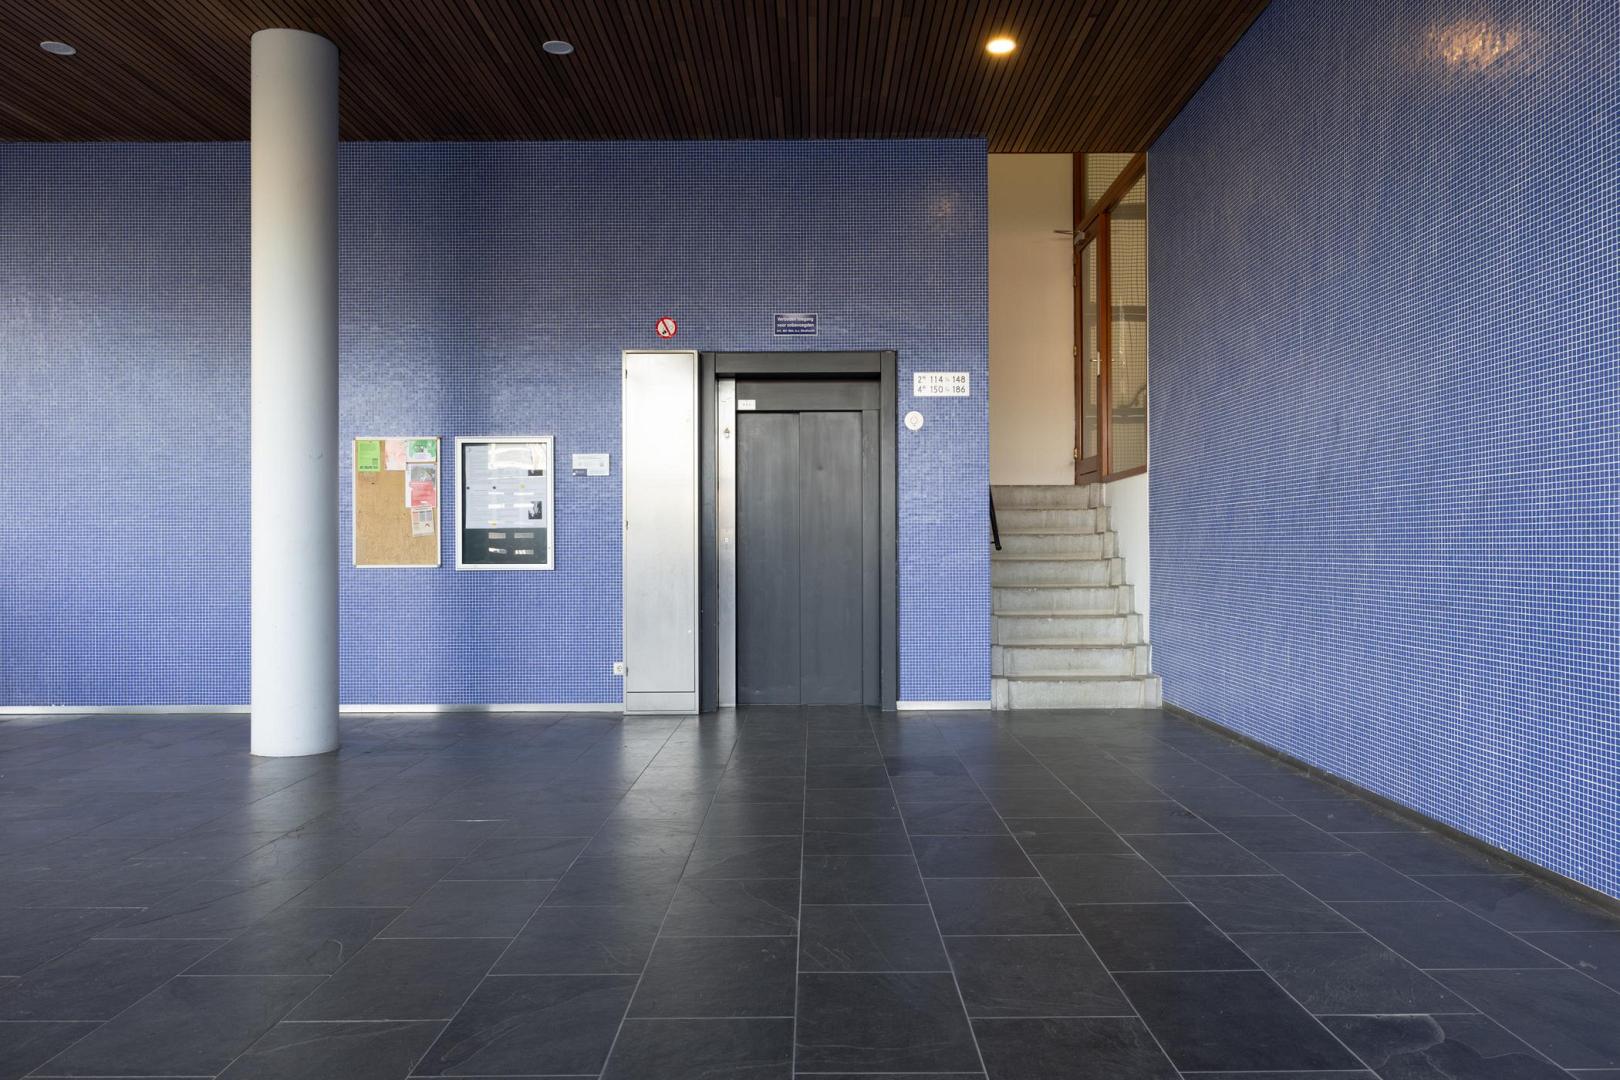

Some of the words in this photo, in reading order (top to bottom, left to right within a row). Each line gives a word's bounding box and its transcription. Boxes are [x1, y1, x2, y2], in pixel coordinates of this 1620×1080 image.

[930, 375, 943, 383] 114
[952, 375, 966, 383] 148
[930, 385, 943, 393] 150
[952, 385, 966, 393] 186
